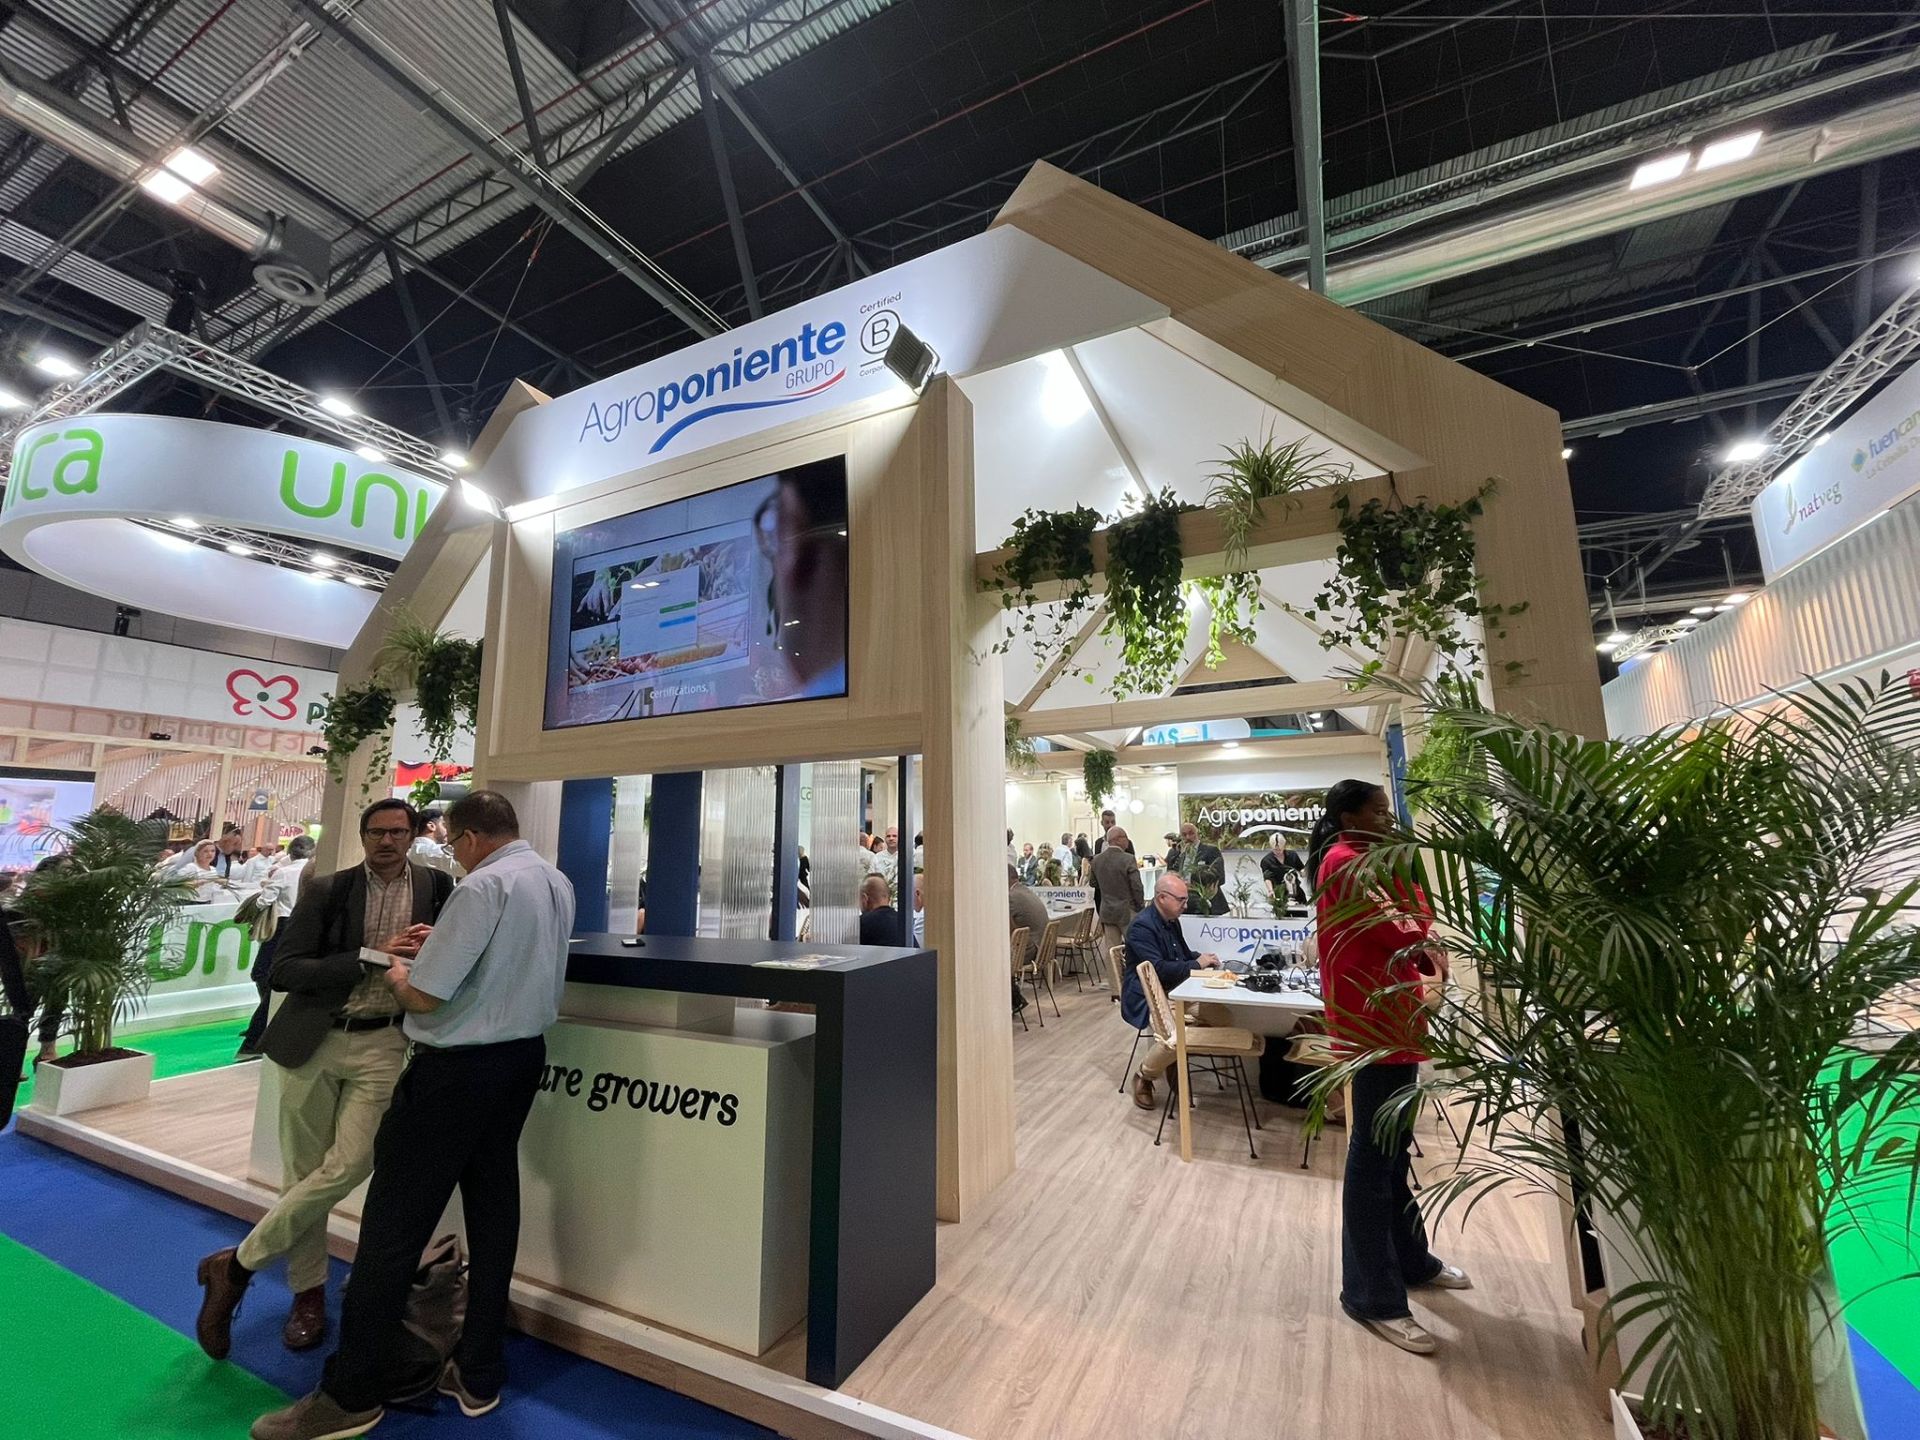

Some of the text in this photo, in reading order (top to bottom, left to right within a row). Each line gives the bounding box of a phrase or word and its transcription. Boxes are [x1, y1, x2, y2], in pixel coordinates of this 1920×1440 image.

[860, 291, 902, 314] Certified
[872, 318, 890, 347] B
[579, 320, 847, 443] Agroponiente
[785, 359, 835, 390] GRUPO
[860, 364, 886, 377] Corpor
[280, 450, 428, 541] uni
[1799, 481, 1842, 520] natveg
[1200, 922, 1311, 943] Agroponient
[144, 919, 251, 983] un
[586, 1072, 740, 1127] growers
